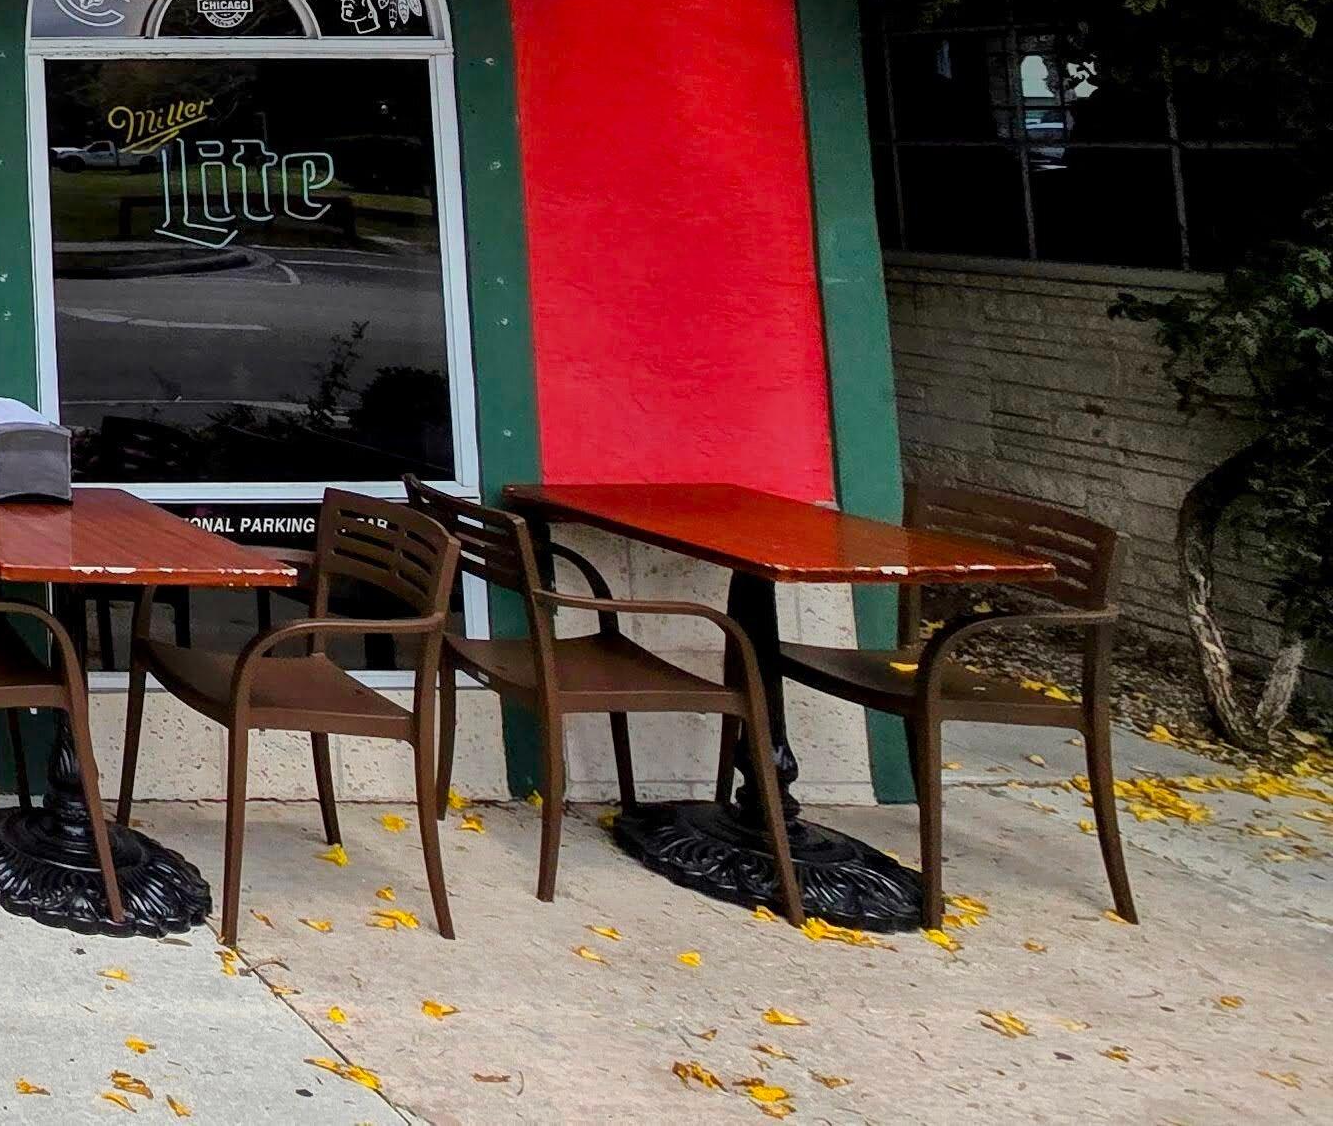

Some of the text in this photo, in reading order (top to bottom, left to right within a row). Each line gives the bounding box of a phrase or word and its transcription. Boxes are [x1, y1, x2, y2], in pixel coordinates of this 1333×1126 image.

[202, 0, 249, 11] CHICAGO
[108, 97, 214, 143] Miller
[154, 138, 334, 248] Lite
[240, 517, 316, 533] PARKING
